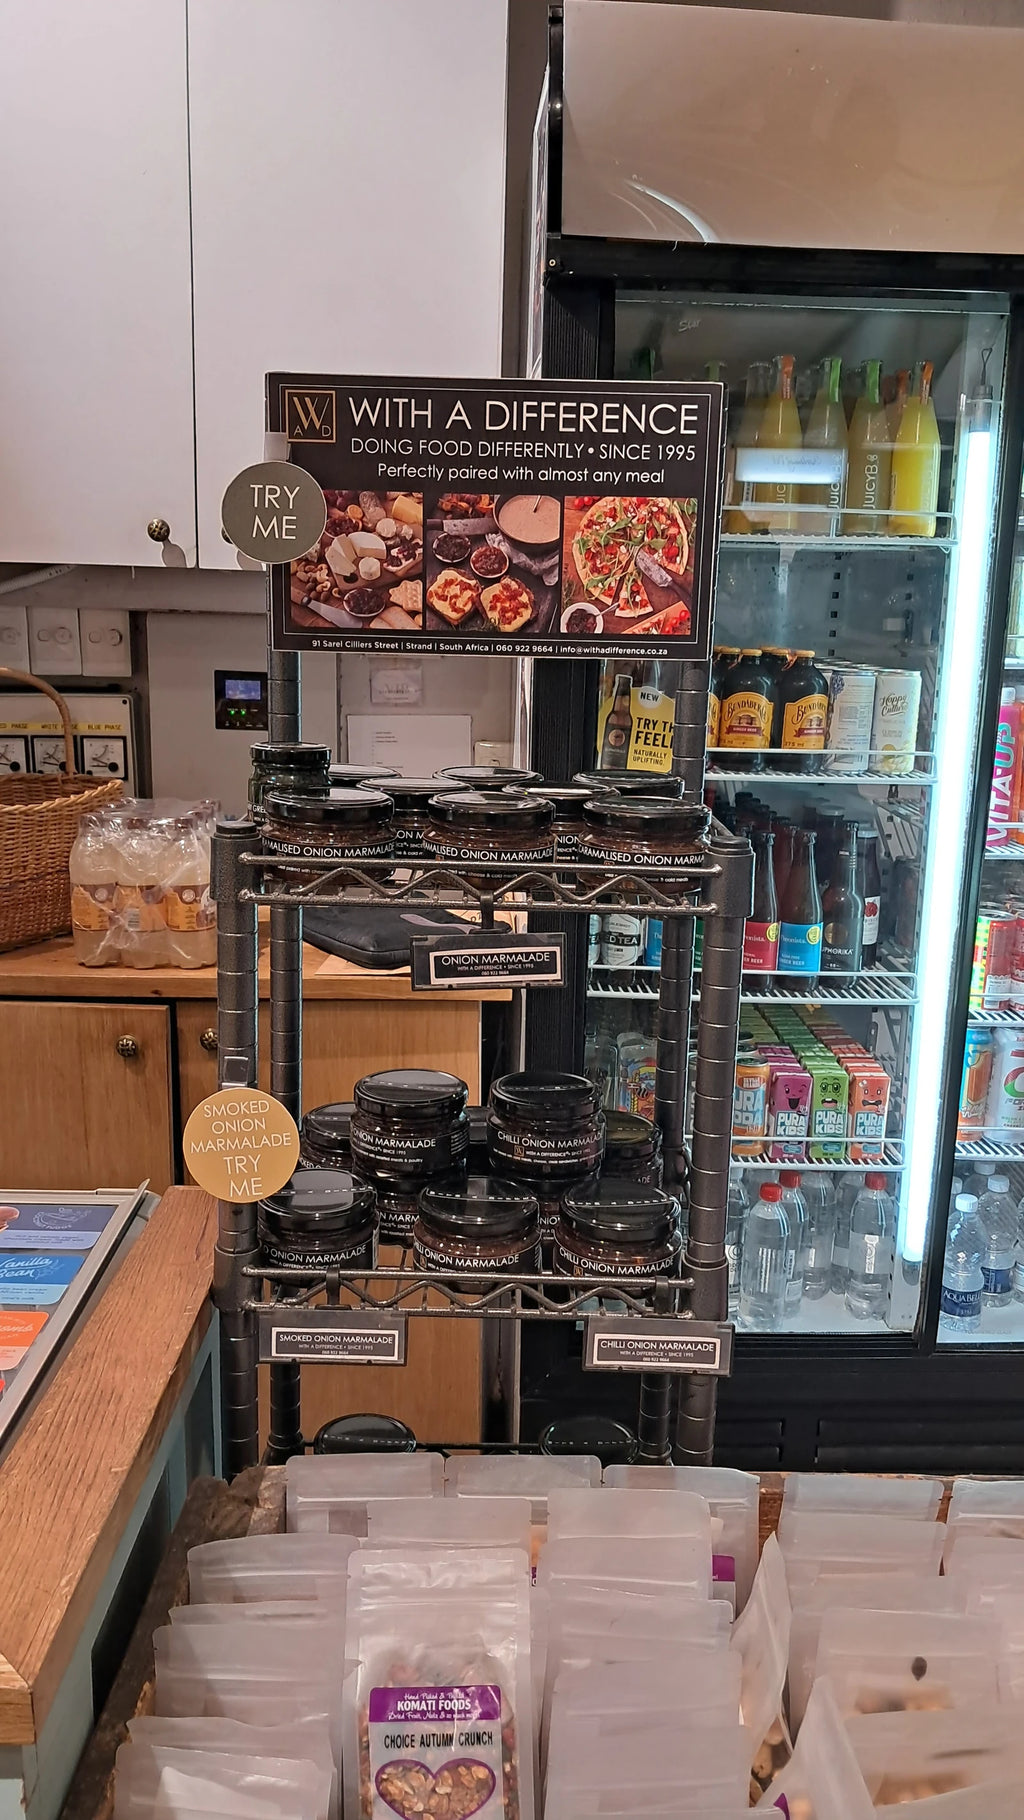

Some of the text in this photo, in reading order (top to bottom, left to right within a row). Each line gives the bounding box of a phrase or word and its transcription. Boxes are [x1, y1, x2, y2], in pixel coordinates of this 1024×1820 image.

[348, 396, 699, 435] WITH A DIFFERENCE
[351, 437, 696, 462] DOING FOOD DIFFERENTLY SINCE 1995
[378, 463, 665, 485] Perfectly paired with almost any meal
[249, 484, 300, 510] TRY
[252, 514, 297, 540] ME
[311, 640, 668, 656] 91 Sarel Cilliers Street Strand South Africa 060 922 9664 info@withadifference.co.za
[640, 691, 660, 702] NEW
[636, 716, 674, 733] TRY TH
[632, 755, 665, 766] UPLIFTING.
[633, 748, 667, 759] NATURALLY
[303, 846, 342, 858] ONION
[344, 841, 395, 857] MARMALADE
[460, 849, 498, 860] ONION
[500, 846, 553, 861] MARMALADE
[633, 854, 671, 865] ONION
[674, 853, 705, 865] MARMA
[619, 936, 638, 945] TEA
[441, 952, 550, 966] ONION MARMALADE
[203, 1100, 270, 1118] SMOKED
[815, 1110, 844, 1124] PURA
[211, 1117, 266, 1135] ONION
[778, 1112, 805, 1127] PURA
[776, 1124, 805, 1136] KIDS
[815, 1123, 844, 1134] KIDS
[856, 1124, 884, 1136] KIDS
[190, 1132, 292, 1154] MARMALADE
[375, 1138, 436, 1149] MARMALADE
[497, 1130, 603, 1149] CHILLI ONION MARMALAD
[223, 1154, 261, 1175] TRY
[229, 1177, 263, 1198] ME
[270, 1244, 367, 1264] ONION MARMALADE
[424, 1248, 520, 1268] ONION MARMALADE
[559, 1246, 674, 1276] CHILLI ONION MARMALADE
[279, 1334, 393, 1344] SMOKED ONION MARMALADE
[600, 1340, 714, 1352] CHILLI ONION MARMALADE
[397, 1699, 472, 1711] KOMATI FOODS
[388, 1711, 405, 1720] Dried
[383, 1731, 493, 1749] CHOICE AUTUMN CRUNCH
